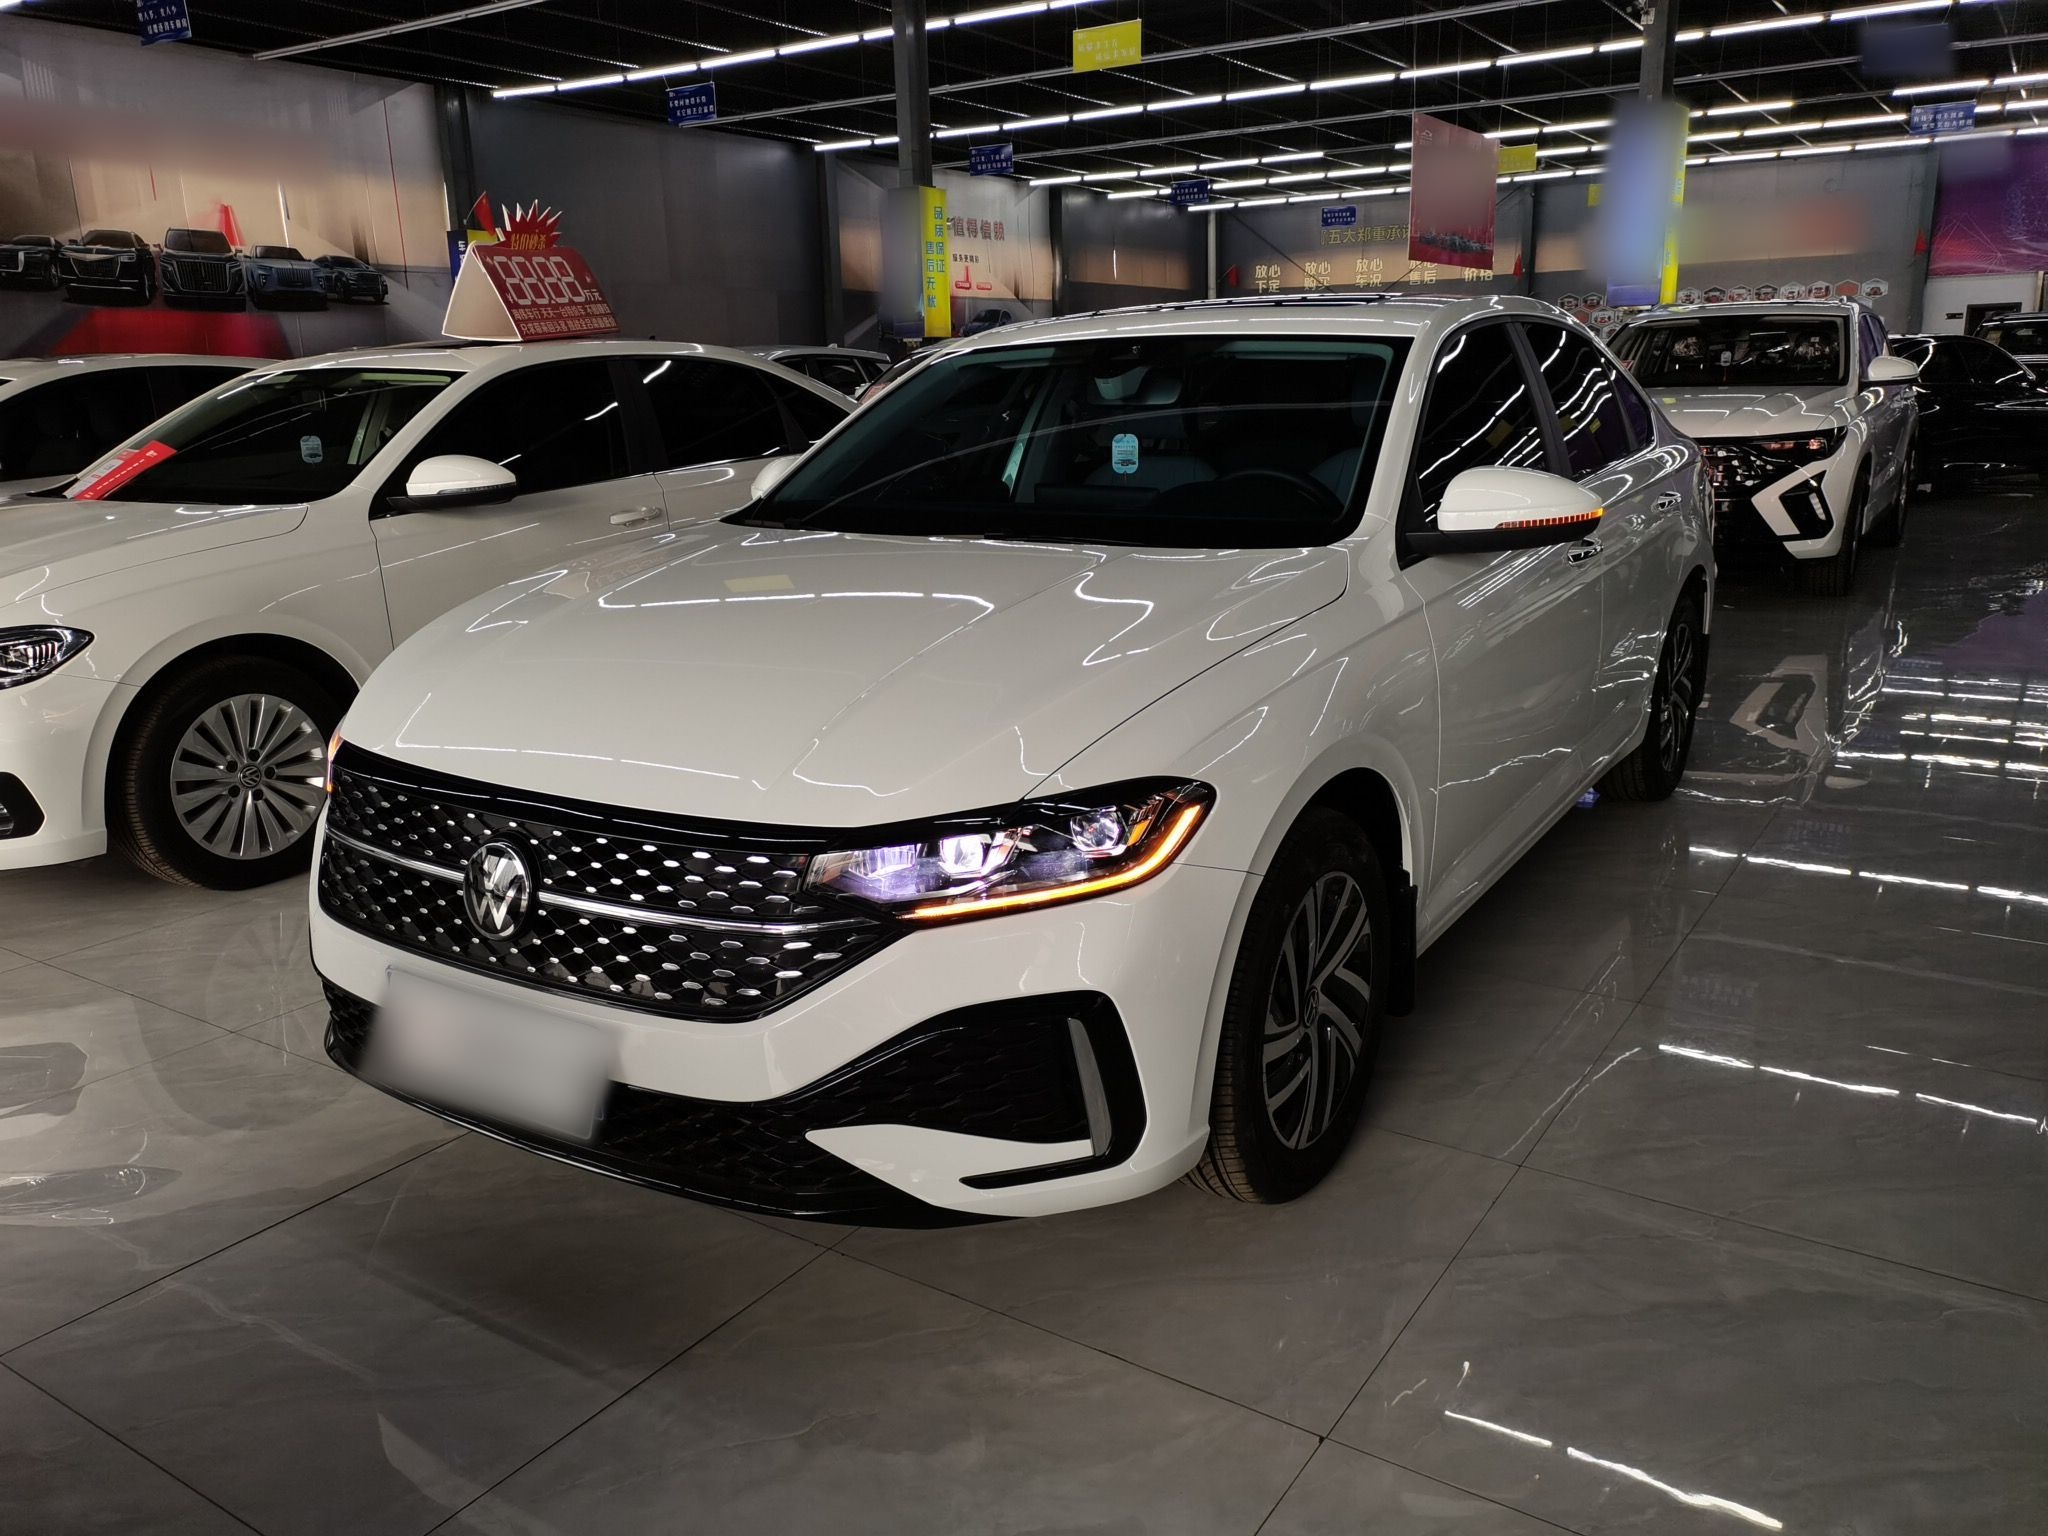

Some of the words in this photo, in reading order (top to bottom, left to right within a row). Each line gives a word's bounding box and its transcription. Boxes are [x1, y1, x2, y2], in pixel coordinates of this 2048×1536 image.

[934, 206, 945, 273] 品质保证
[1256, 264, 1280, 278] 放心
[1305, 261, 1330, 275] 放心
[1356, 258, 1383, 272] 放心
[1355, 273, 1383, 288] 车况
[1409, 271, 1437, 285] 售后
[1256, 280, 1280, 293] 下定
